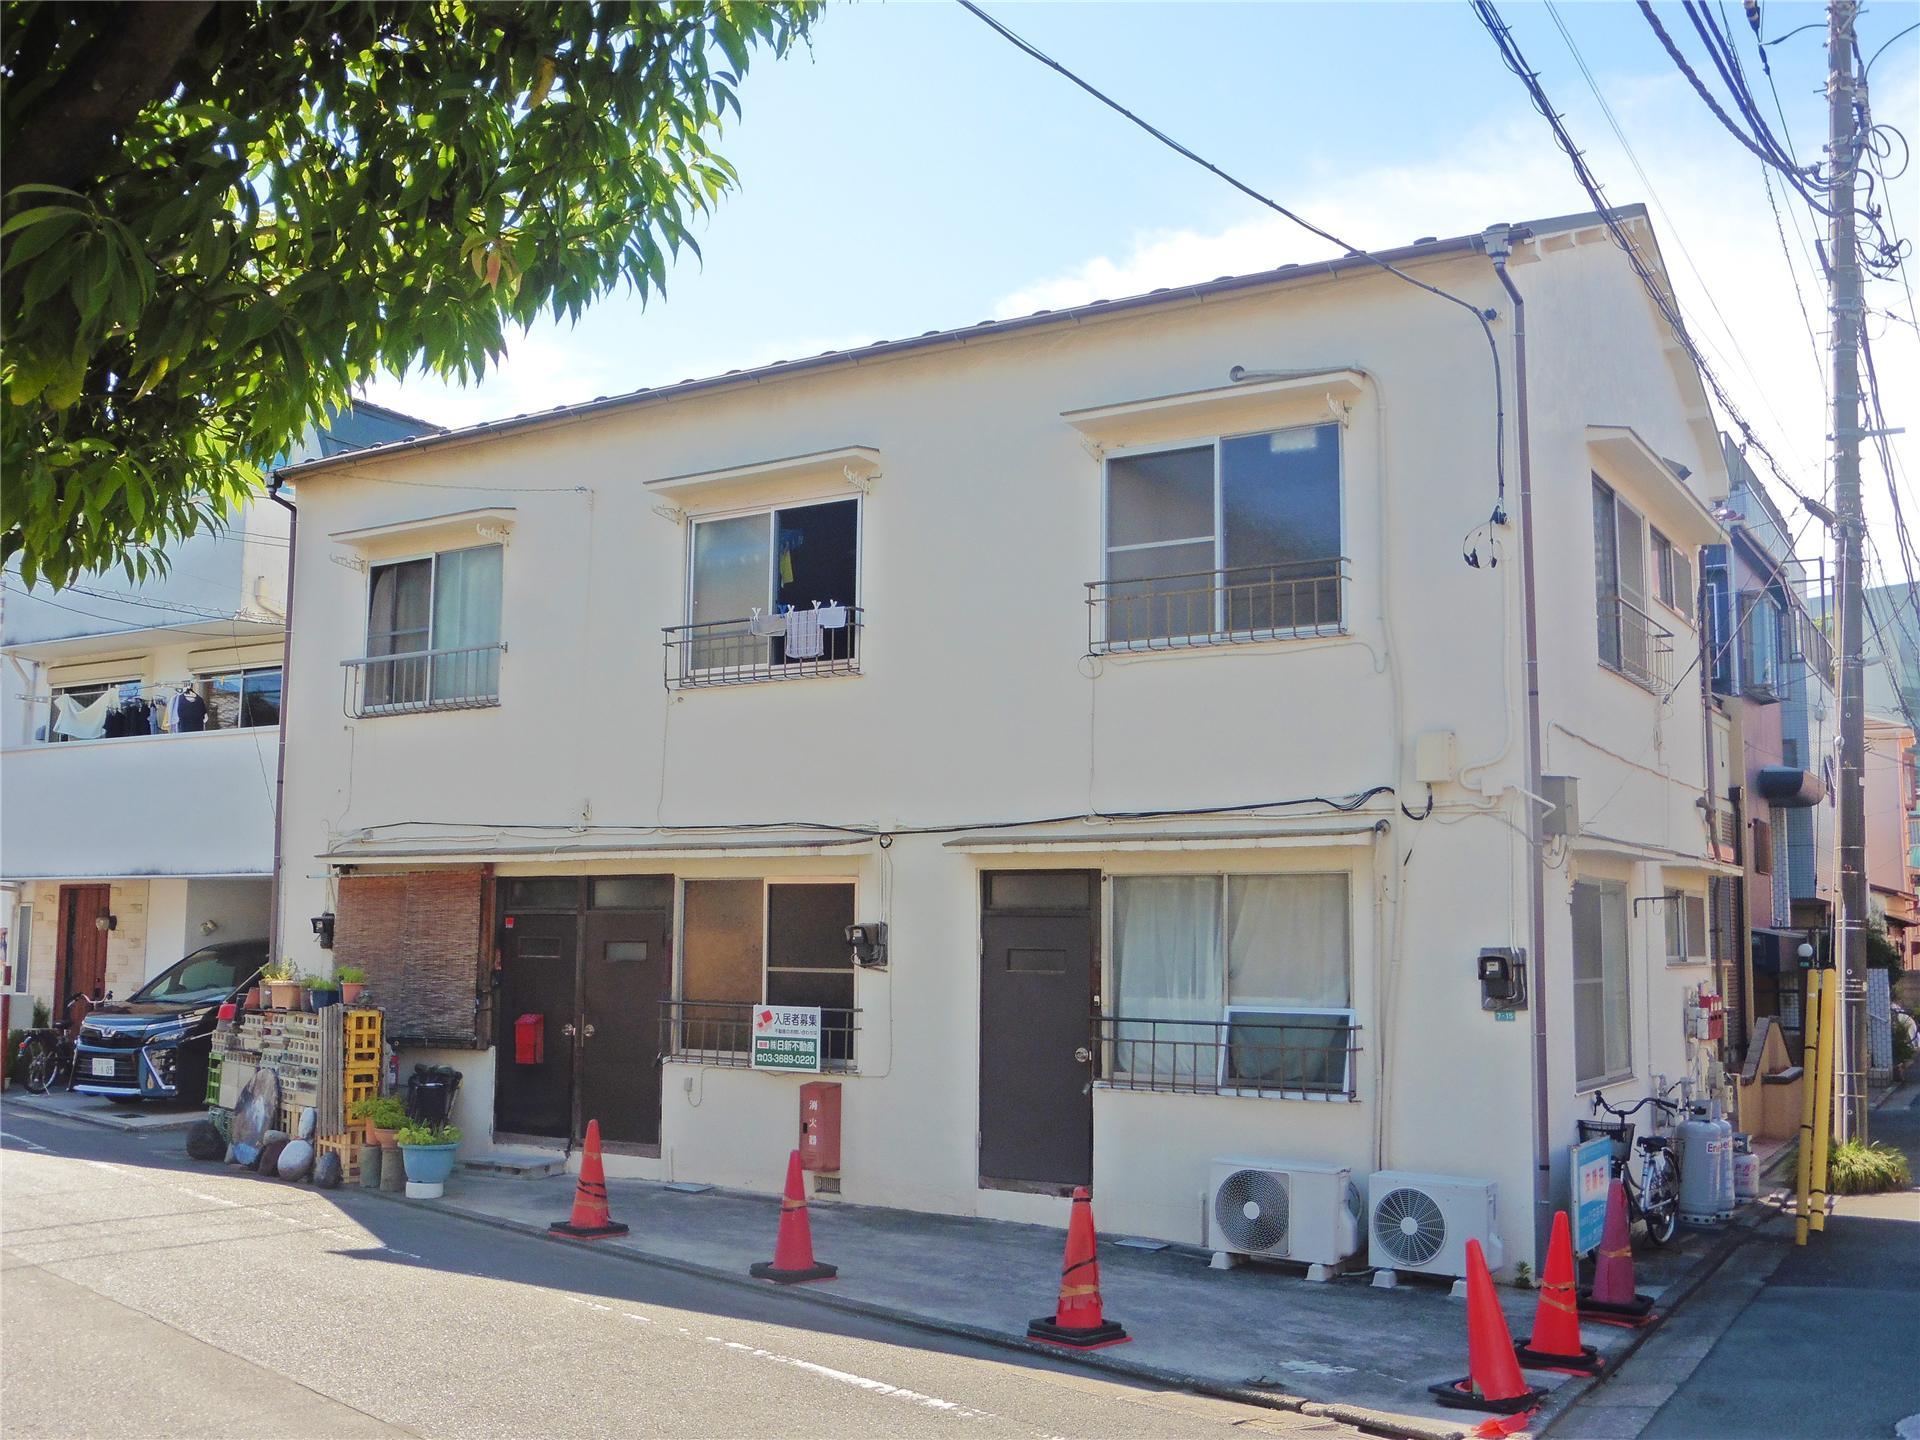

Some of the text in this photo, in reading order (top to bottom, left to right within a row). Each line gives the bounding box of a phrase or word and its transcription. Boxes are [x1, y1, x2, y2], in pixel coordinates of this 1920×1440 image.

[774, 1012, 817, 1027] 入居者募集
